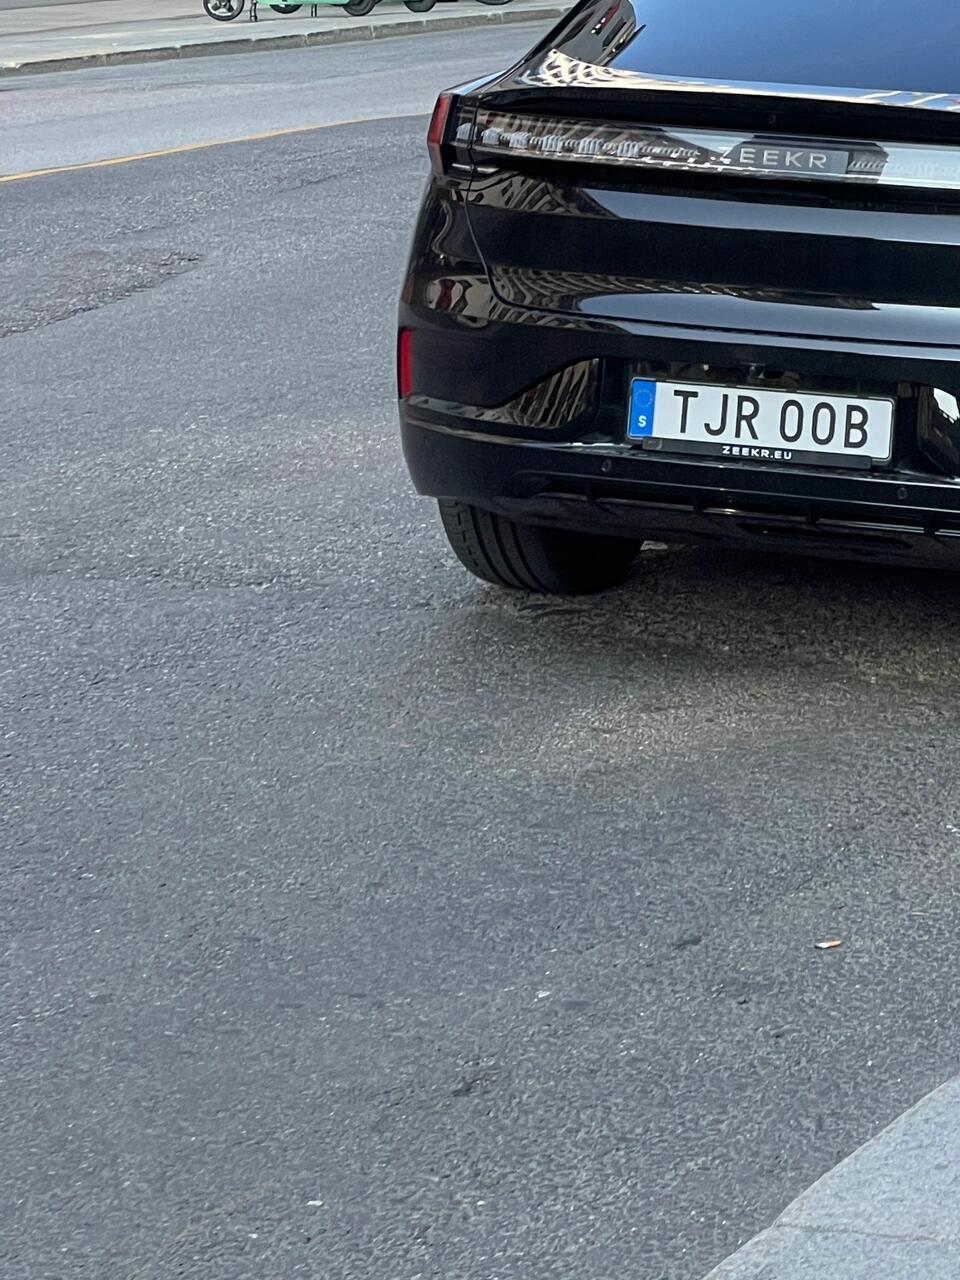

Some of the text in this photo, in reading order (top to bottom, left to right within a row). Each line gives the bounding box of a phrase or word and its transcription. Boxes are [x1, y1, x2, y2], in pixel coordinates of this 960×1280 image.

[718, 146, 827, 169] ZEEKR
[637, 415, 647, 428] S
[673, 389, 760, 440] TJR
[721, 445, 793, 461] ZEEKR.EU
